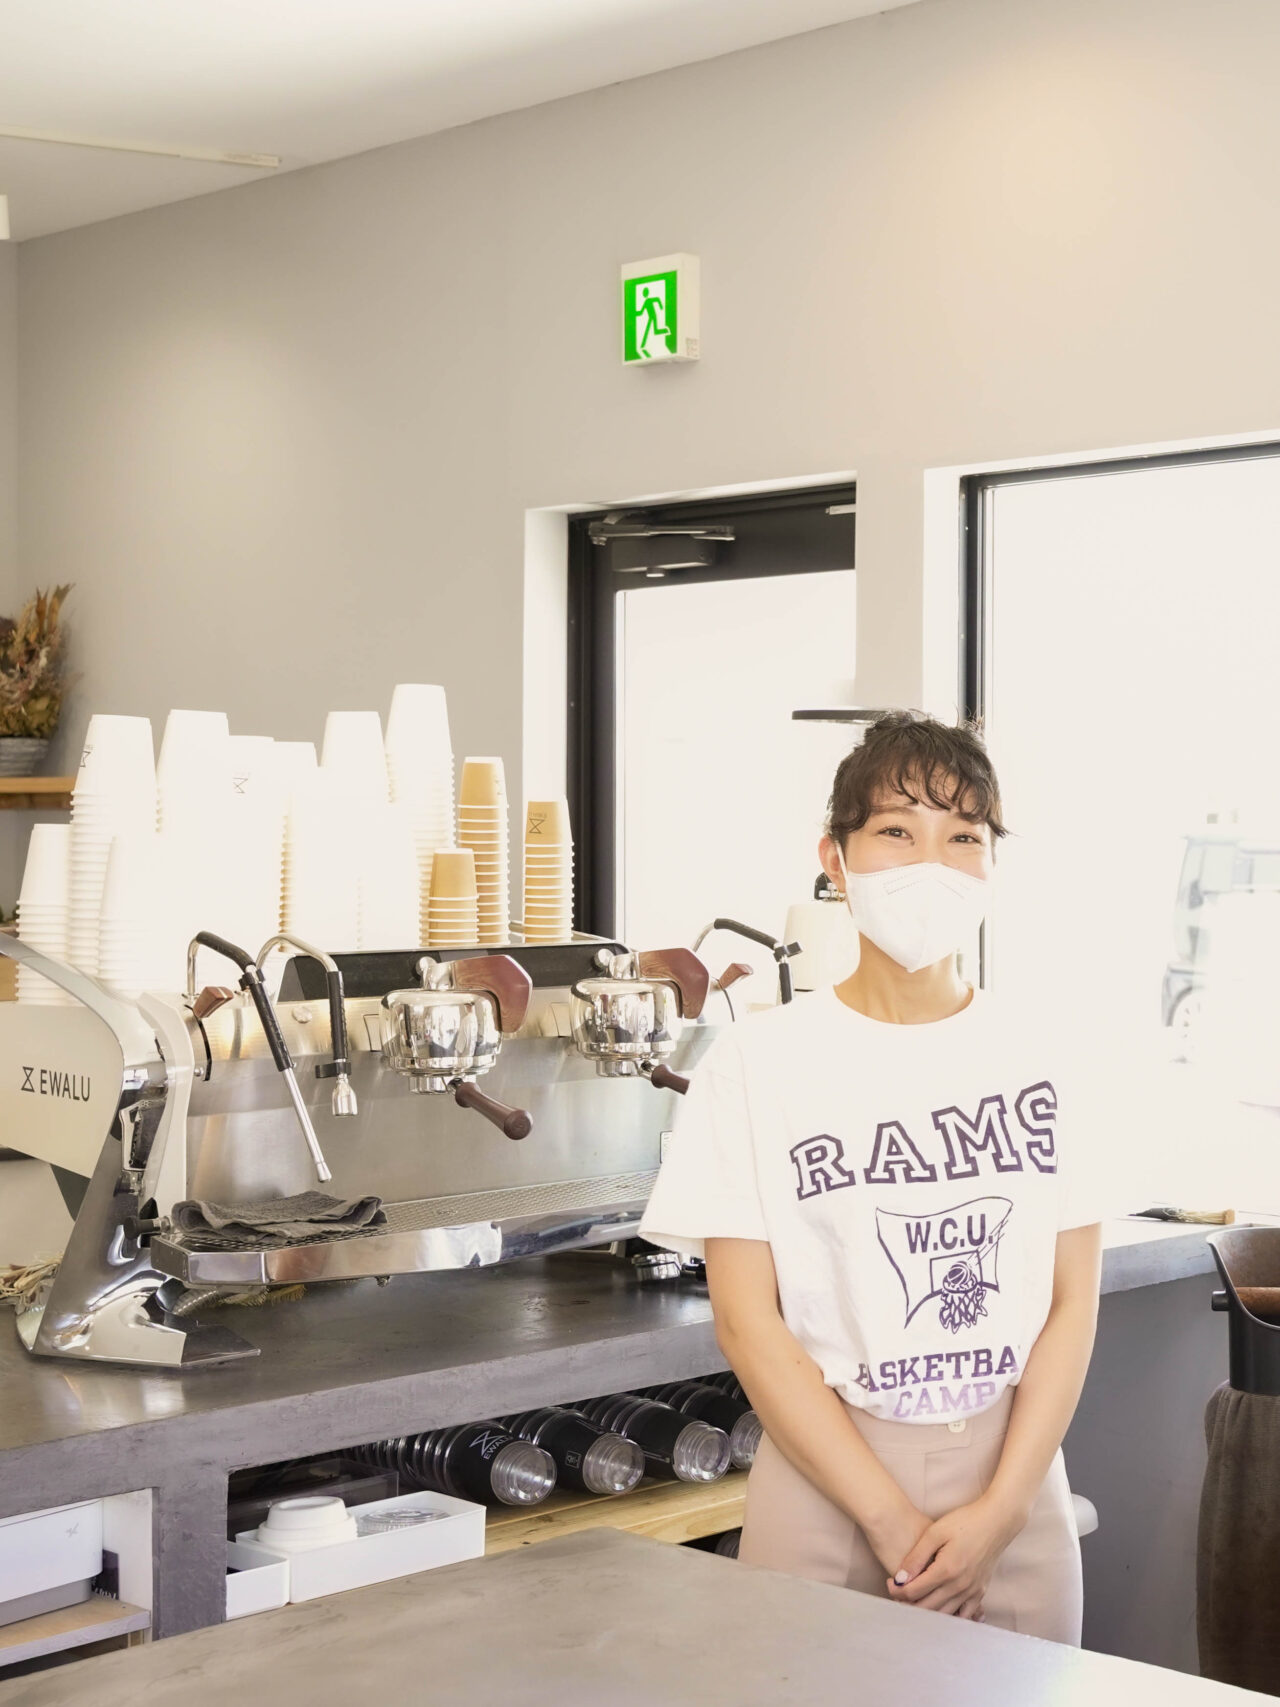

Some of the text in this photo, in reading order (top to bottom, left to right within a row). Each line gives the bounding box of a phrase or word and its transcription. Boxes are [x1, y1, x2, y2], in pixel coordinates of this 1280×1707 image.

[40, 1068, 91, 1102] EWALU
[789, 1080, 1058, 1201] RAMS
[905, 1213, 994, 1254] W.C.U.
[893, 1381, 997, 1418] CAMP
